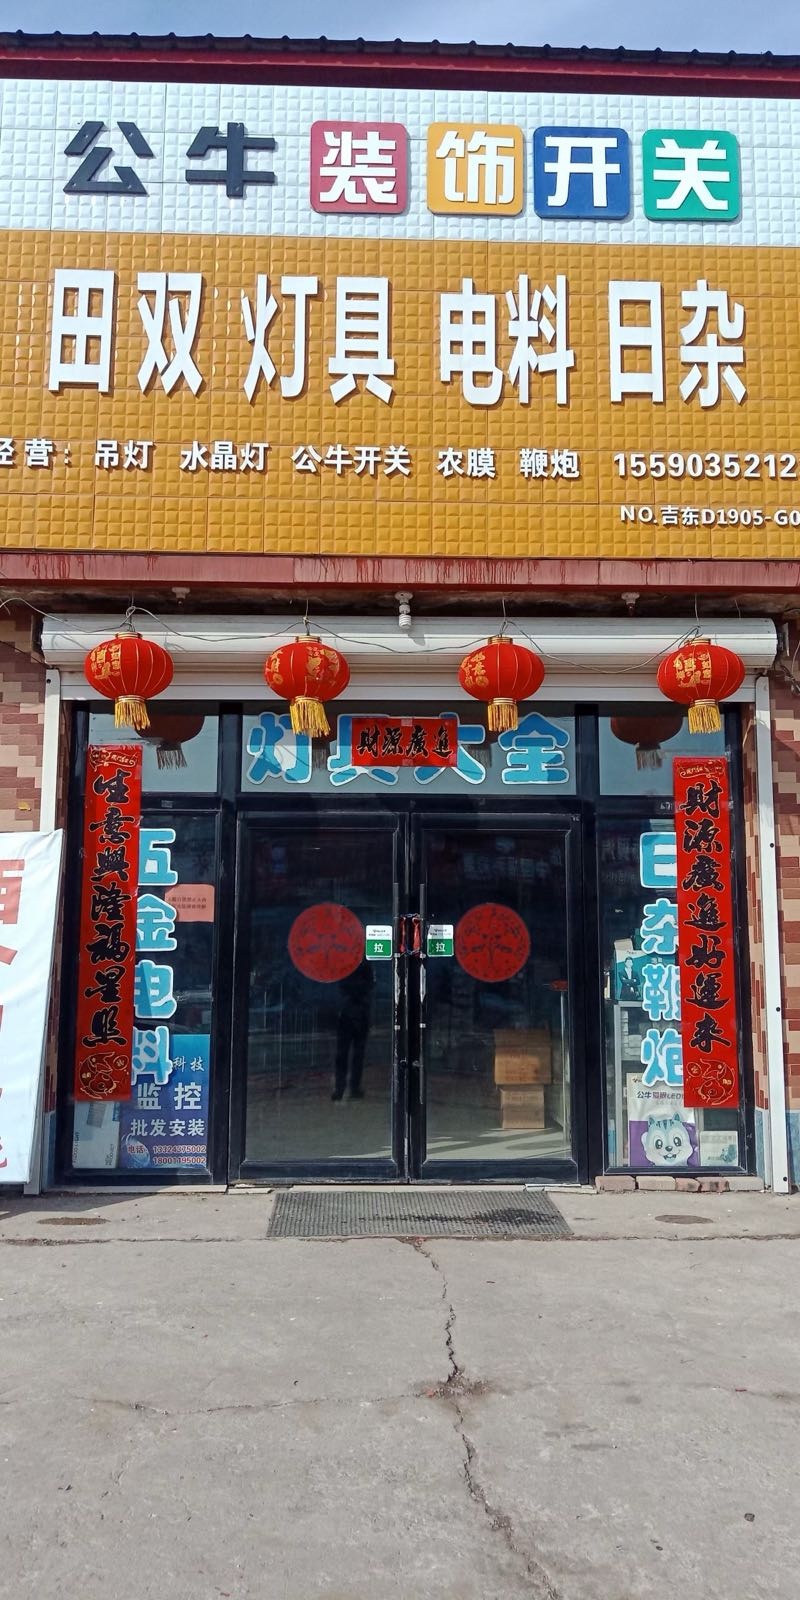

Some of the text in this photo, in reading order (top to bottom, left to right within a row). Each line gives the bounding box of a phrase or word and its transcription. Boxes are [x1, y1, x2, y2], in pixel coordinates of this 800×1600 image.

[63, 120, 732, 213] 公牛装饰开关
[49, 268, 748, 408] 田双 灯具 电料 日杂
[95, 440, 153, 470] 吊灯
[180, 440, 269, 472] 水晶灯
[291, 443, 411, 477] 公牛开关
[436, 447, 496, 479] 农膜
[519, 447, 580, 480] 鞭炮
[614, 452, 798, 479] 1559035212
[374, 942, 384, 953] 拉
[436, 942, 446, 952] 拉
[137, 1082, 202, 1110] 监控
[131, 1118, 205, 1137] 批发安装
